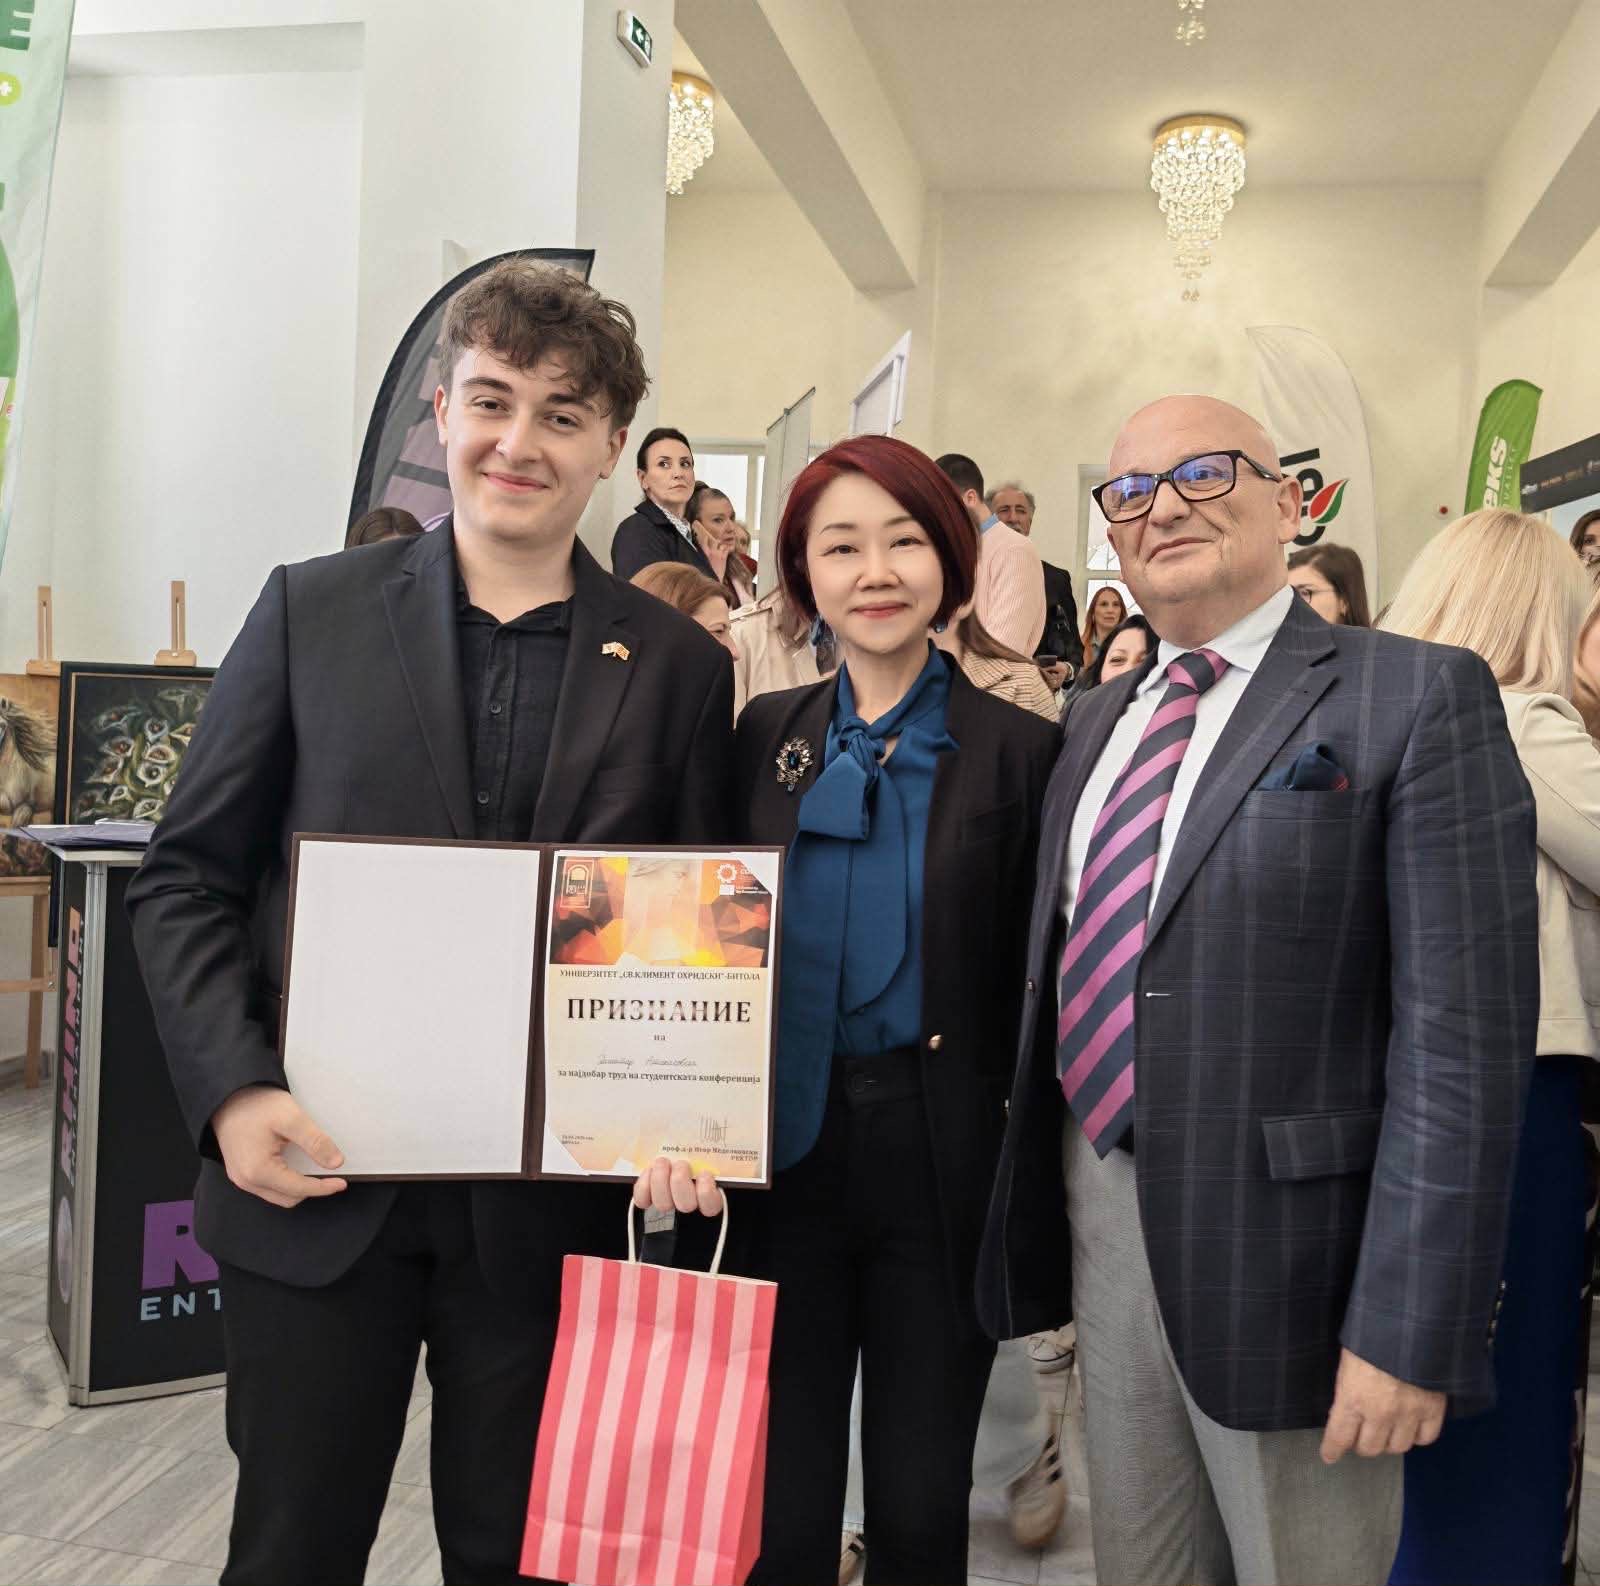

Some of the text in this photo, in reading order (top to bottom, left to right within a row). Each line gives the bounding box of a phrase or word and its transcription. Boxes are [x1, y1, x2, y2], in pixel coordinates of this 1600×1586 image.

[560, 969, 617, 978] УНИВЕРЗИТЕТ
[567, 998, 751, 1023] ПРИЗНАНИЕ
[568, 1070, 606, 1080] најдобар
[608, 1071, 626, 1081] труд
[641, 1072, 697, 1082] студентската
[699, 1074, 761, 1084] конференција
[142, 1200, 219, 1289] R
[140, 1288, 221, 1320] ENT
